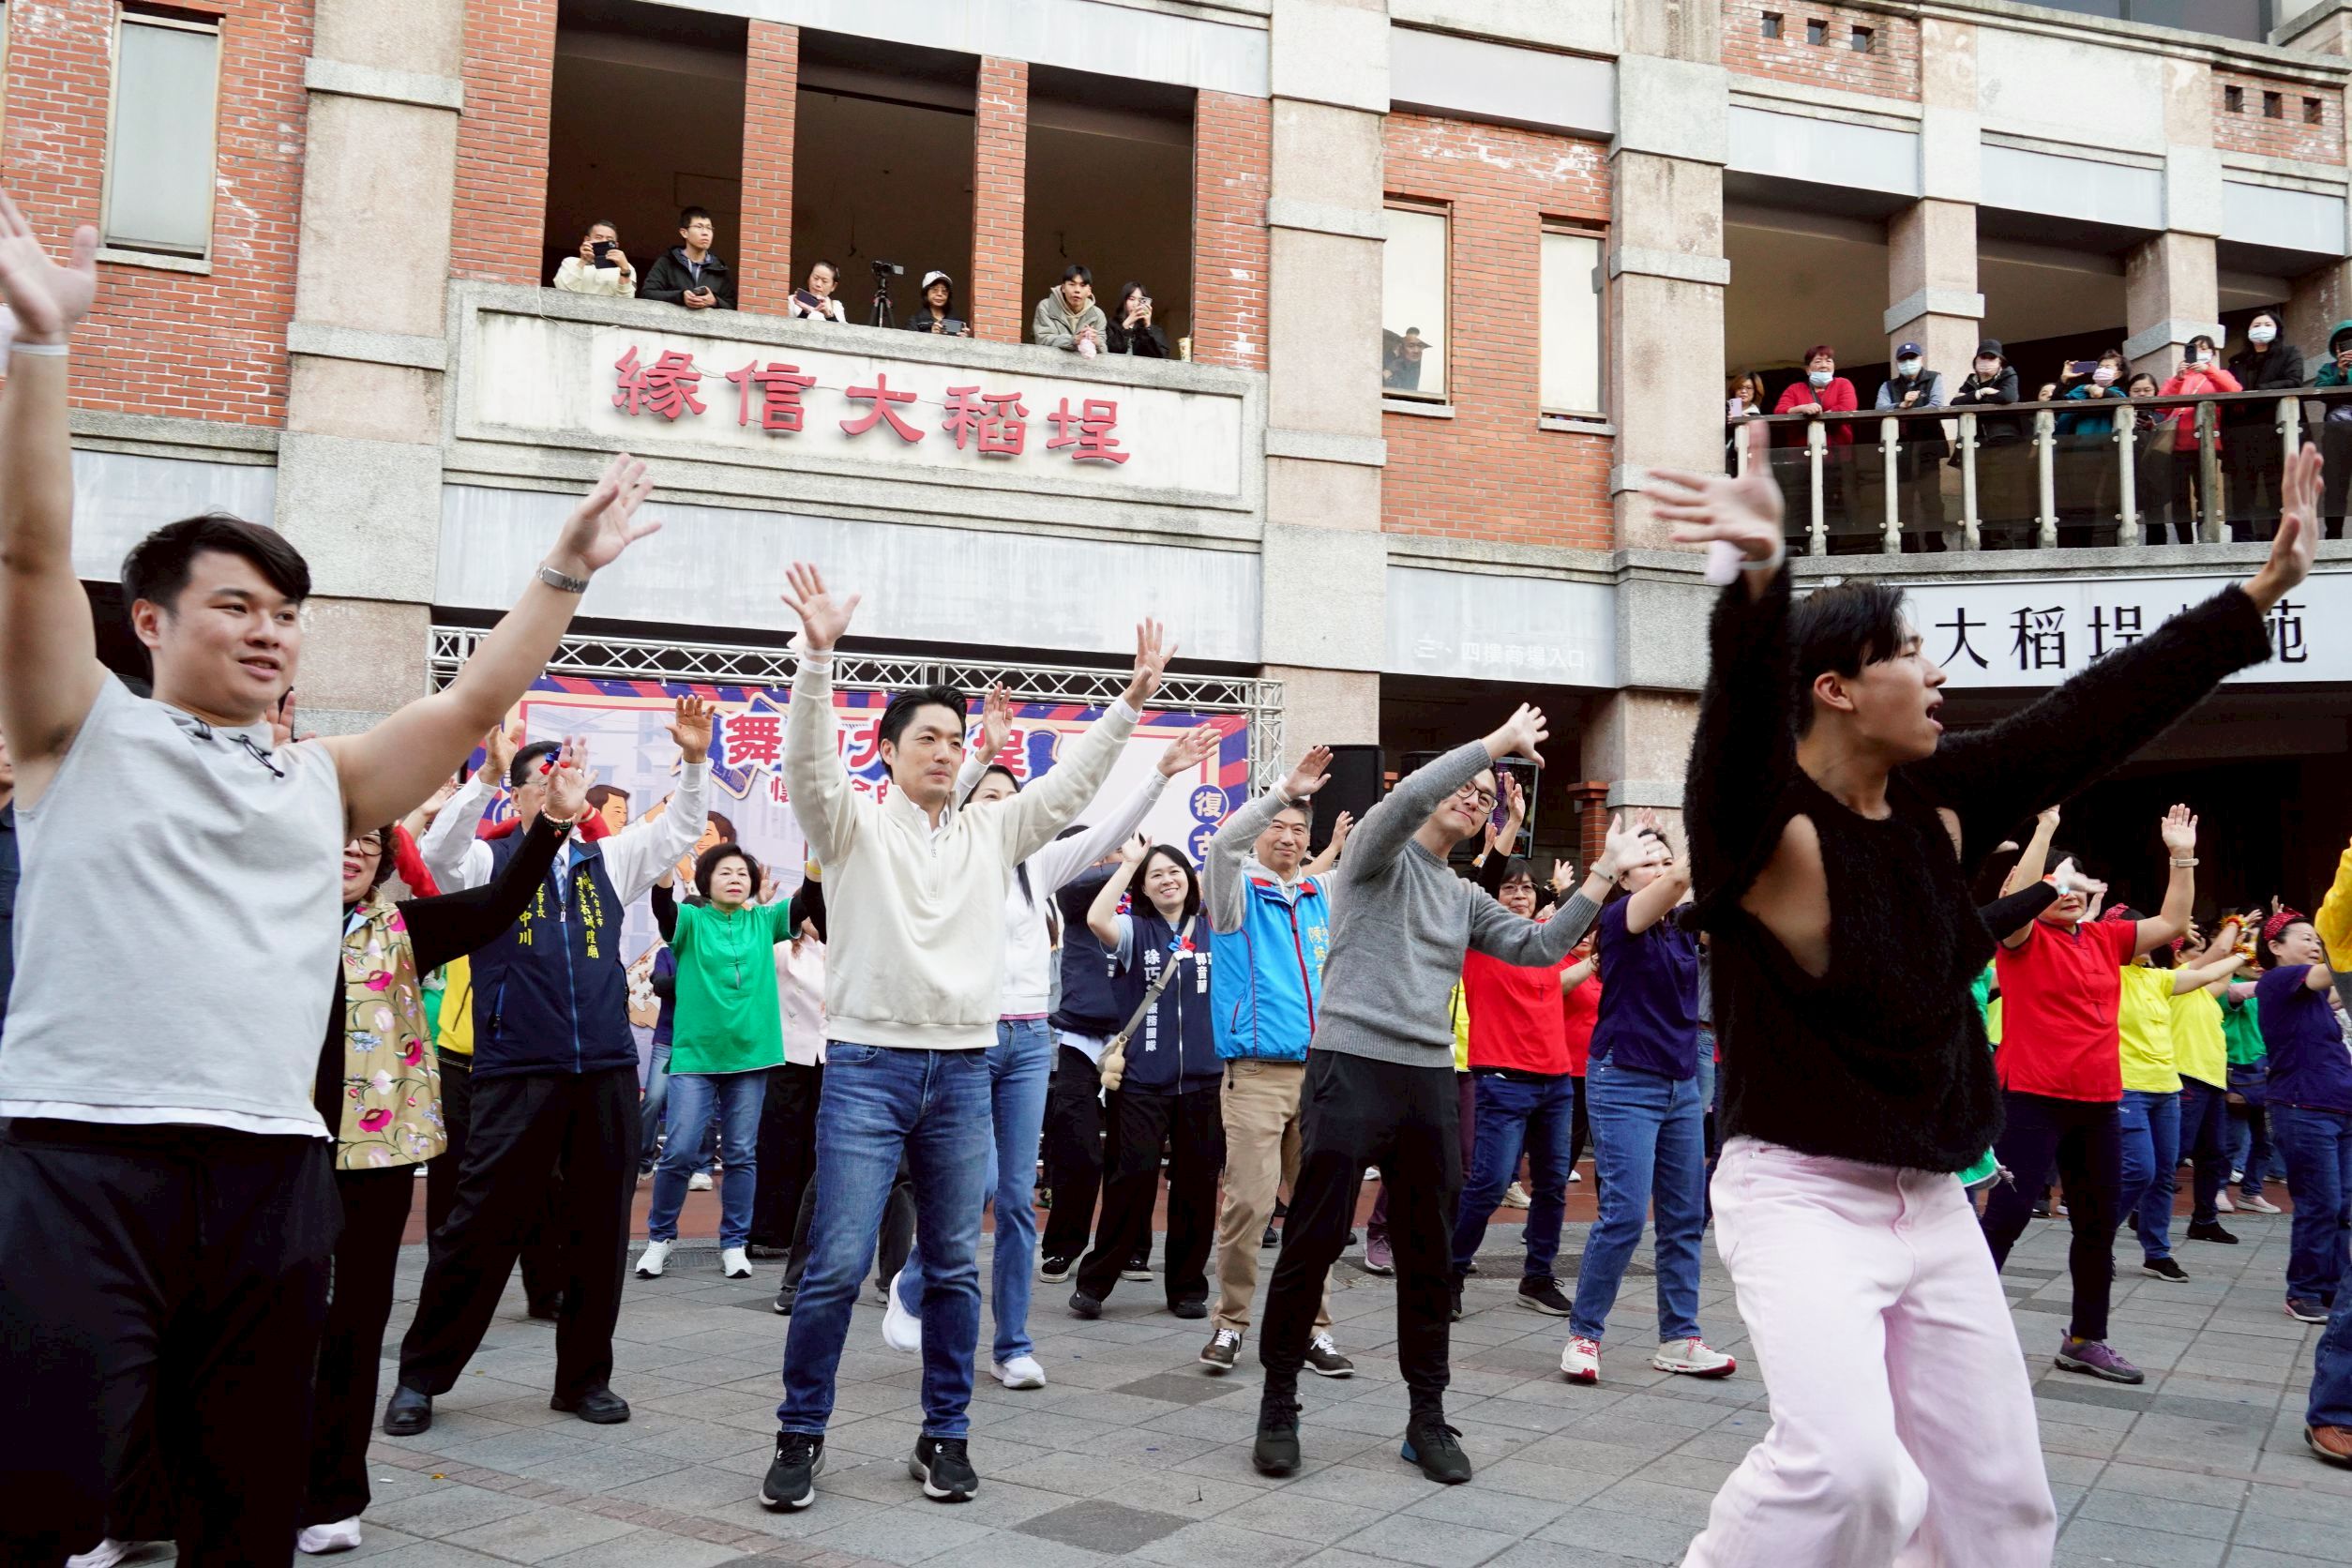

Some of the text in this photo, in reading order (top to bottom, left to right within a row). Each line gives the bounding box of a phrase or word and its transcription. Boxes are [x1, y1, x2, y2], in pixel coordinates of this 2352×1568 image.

[612, 345, 1130, 464] 緣信大稻埕
[1935, 598, 2309, 671] 大稻埕苑
